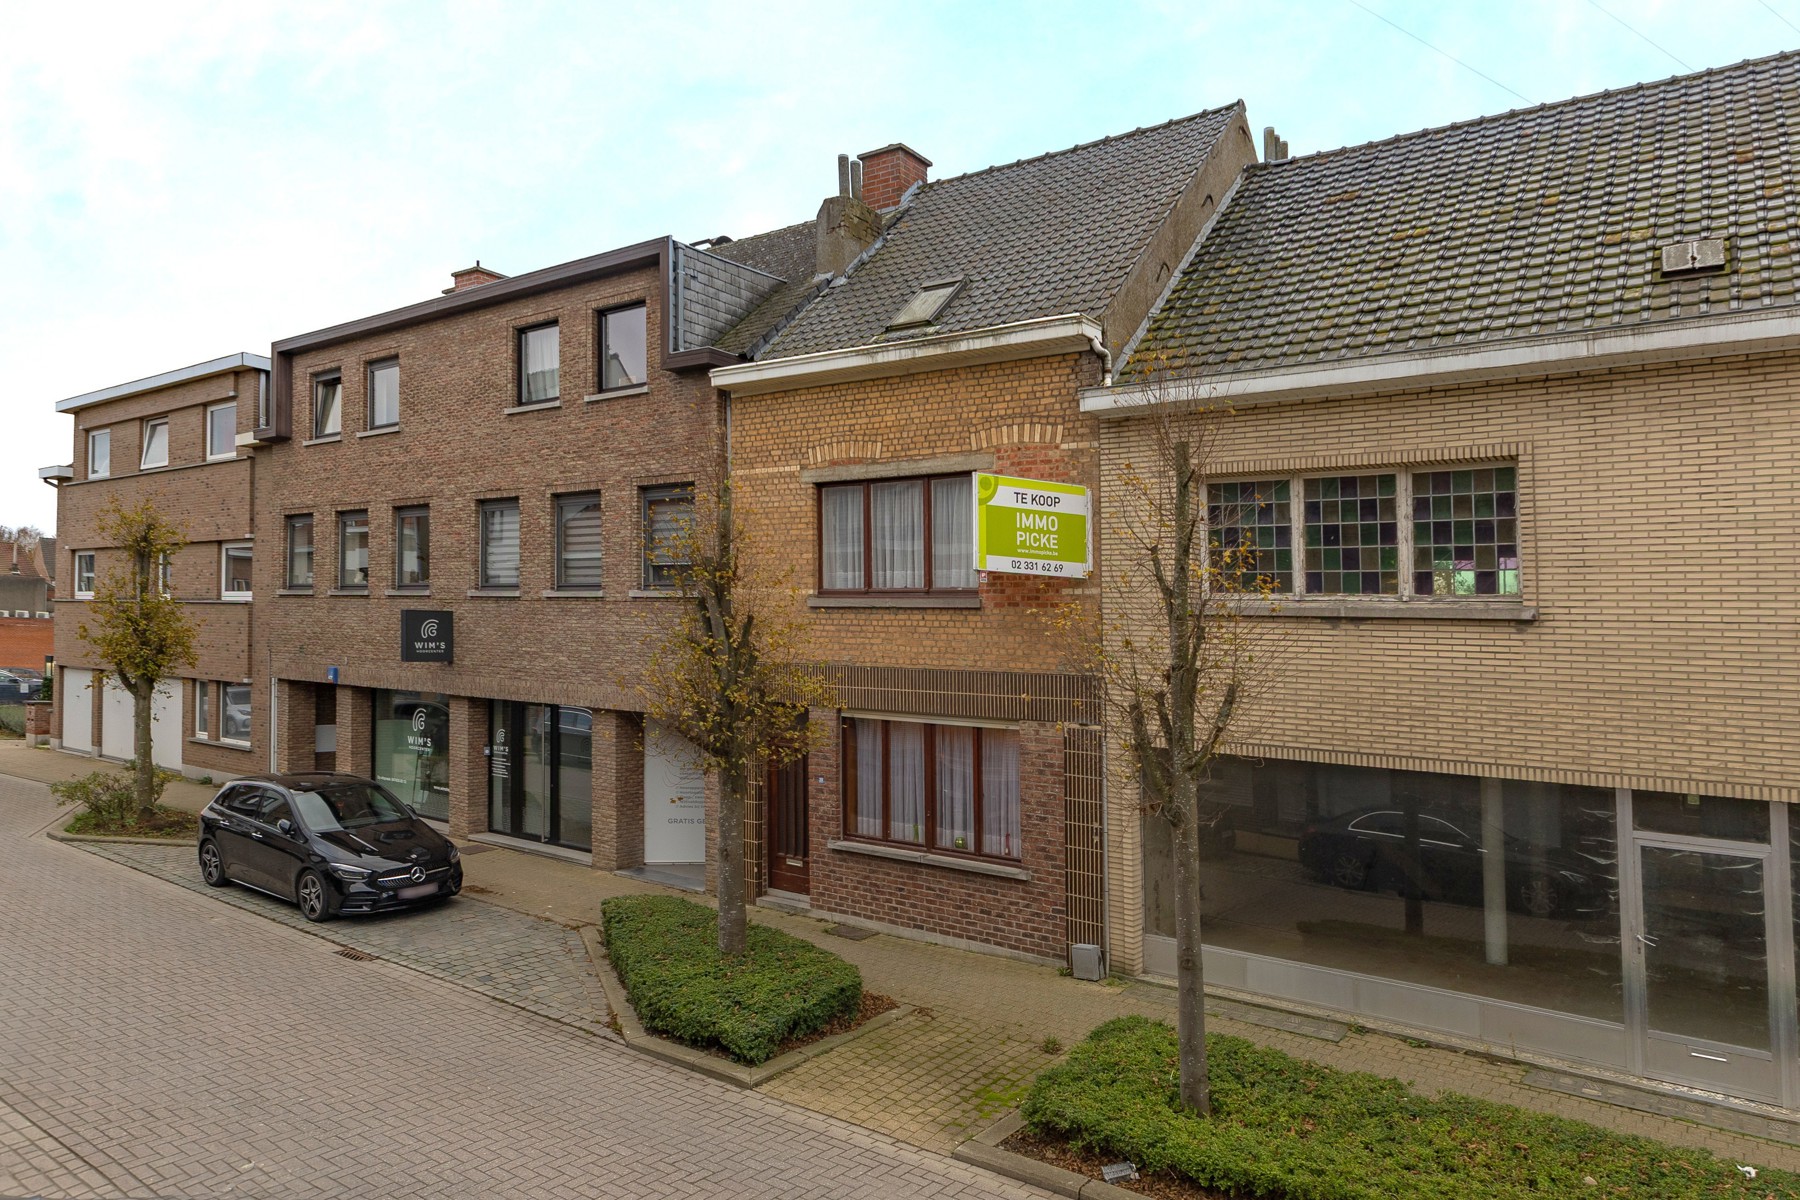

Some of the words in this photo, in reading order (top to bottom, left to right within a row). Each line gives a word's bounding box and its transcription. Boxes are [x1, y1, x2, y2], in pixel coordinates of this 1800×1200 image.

[1014, 492, 1028, 504] TE
[1031, 494, 1060, 508] KOOP
[1016, 512, 1058, 532] IMMO
[1016, 531, 1058, 548] PICKE
[1012, 560, 1021, 569] 02
[1024, 561, 1038, 570] 331
[1042, 562, 1052, 572] 62
[1054, 564, 1064, 572] 69
[408, 736, 432, 747] WIM'S
